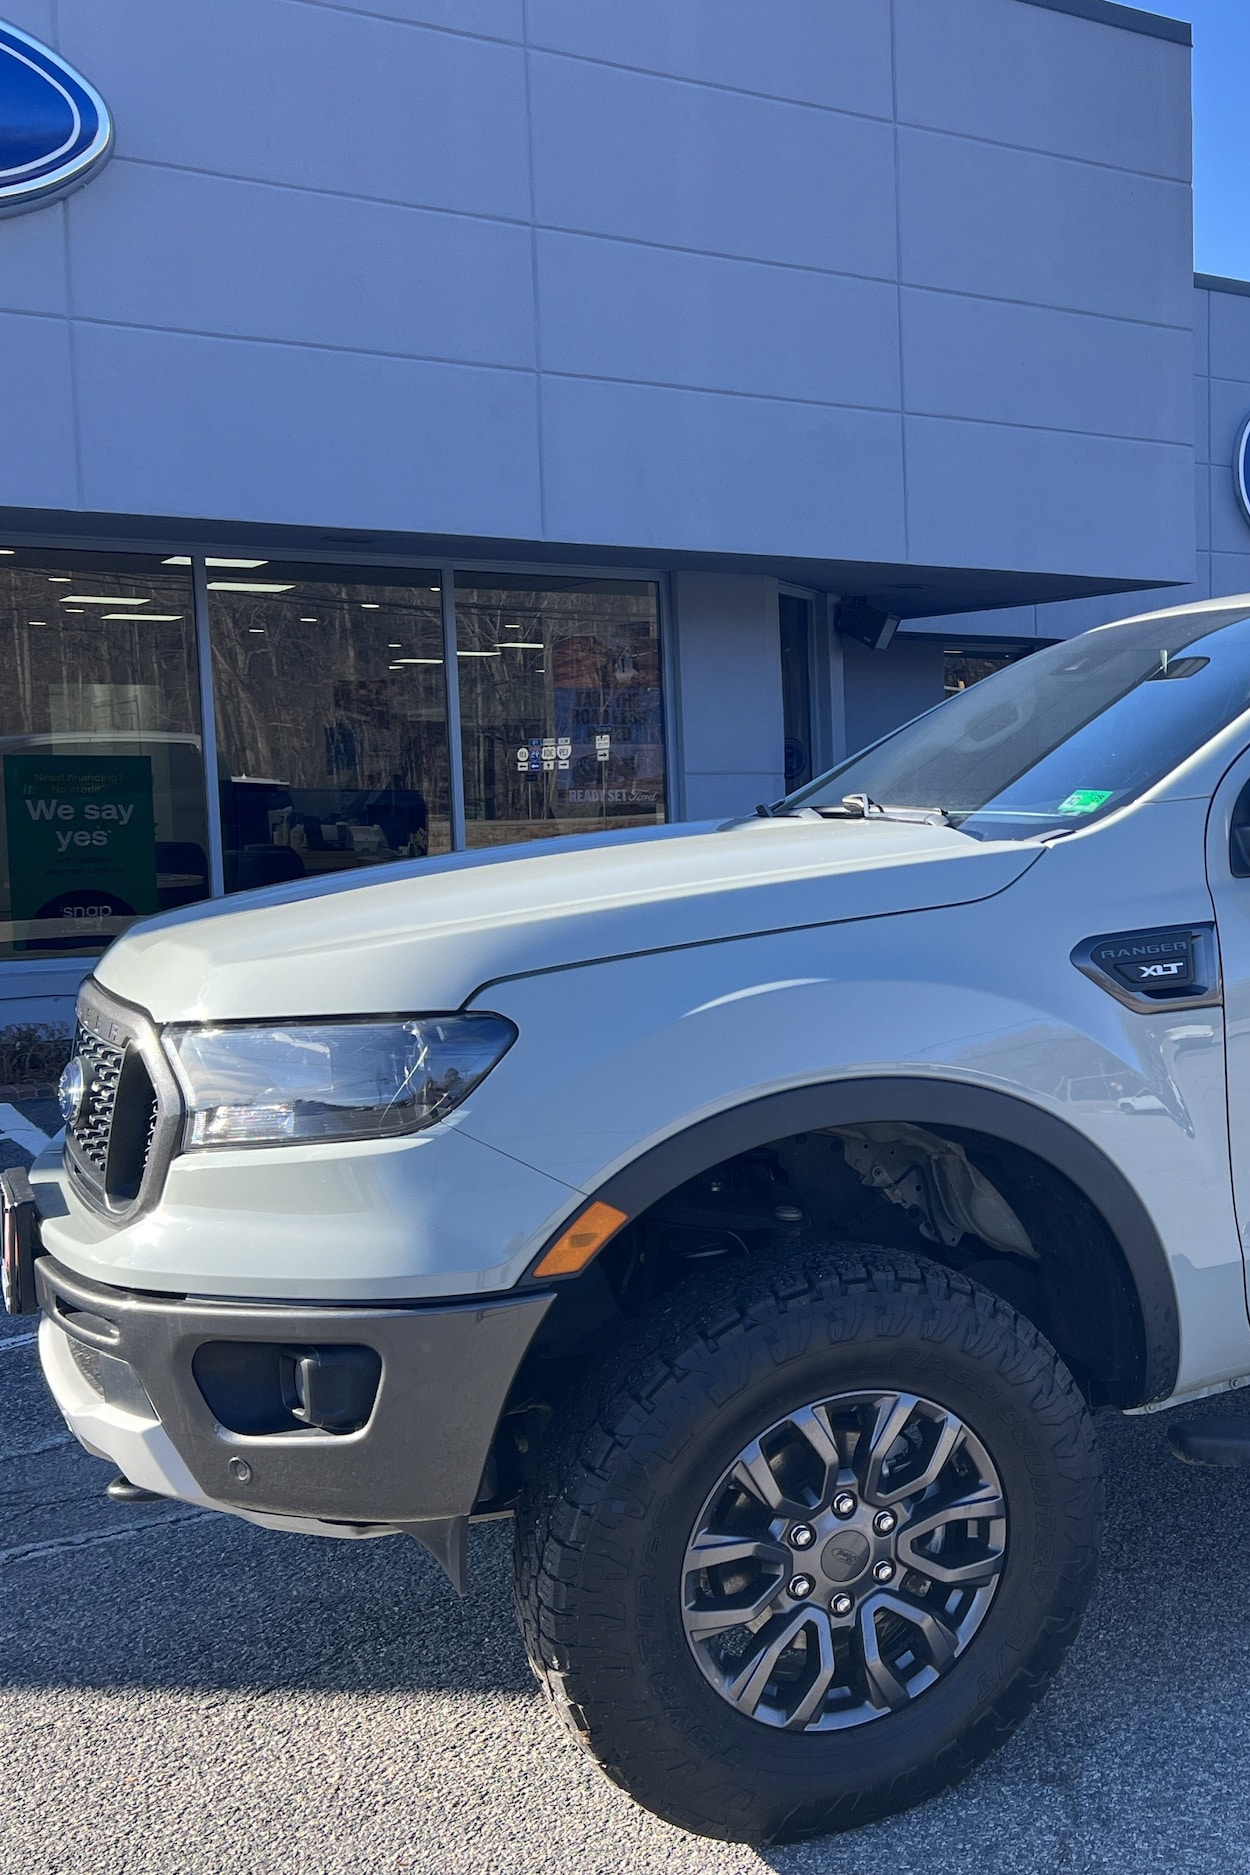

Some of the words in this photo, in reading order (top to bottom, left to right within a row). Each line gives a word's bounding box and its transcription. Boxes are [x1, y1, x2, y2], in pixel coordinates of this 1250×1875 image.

[35, 774, 64, 782] Need
[52, 785, 66, 793] No
[569, 790, 604, 802] READY
[608, 789, 627, 802] SET
[628, 788, 657, 802] Ford
[25, 799, 75, 821] We
[84, 803, 135, 825] say
[56, 829, 109, 852] yes
[63, 905, 112, 920] snap
[1101, 941, 1187, 960] RANGER
[1138, 962, 1184, 978] XLT
